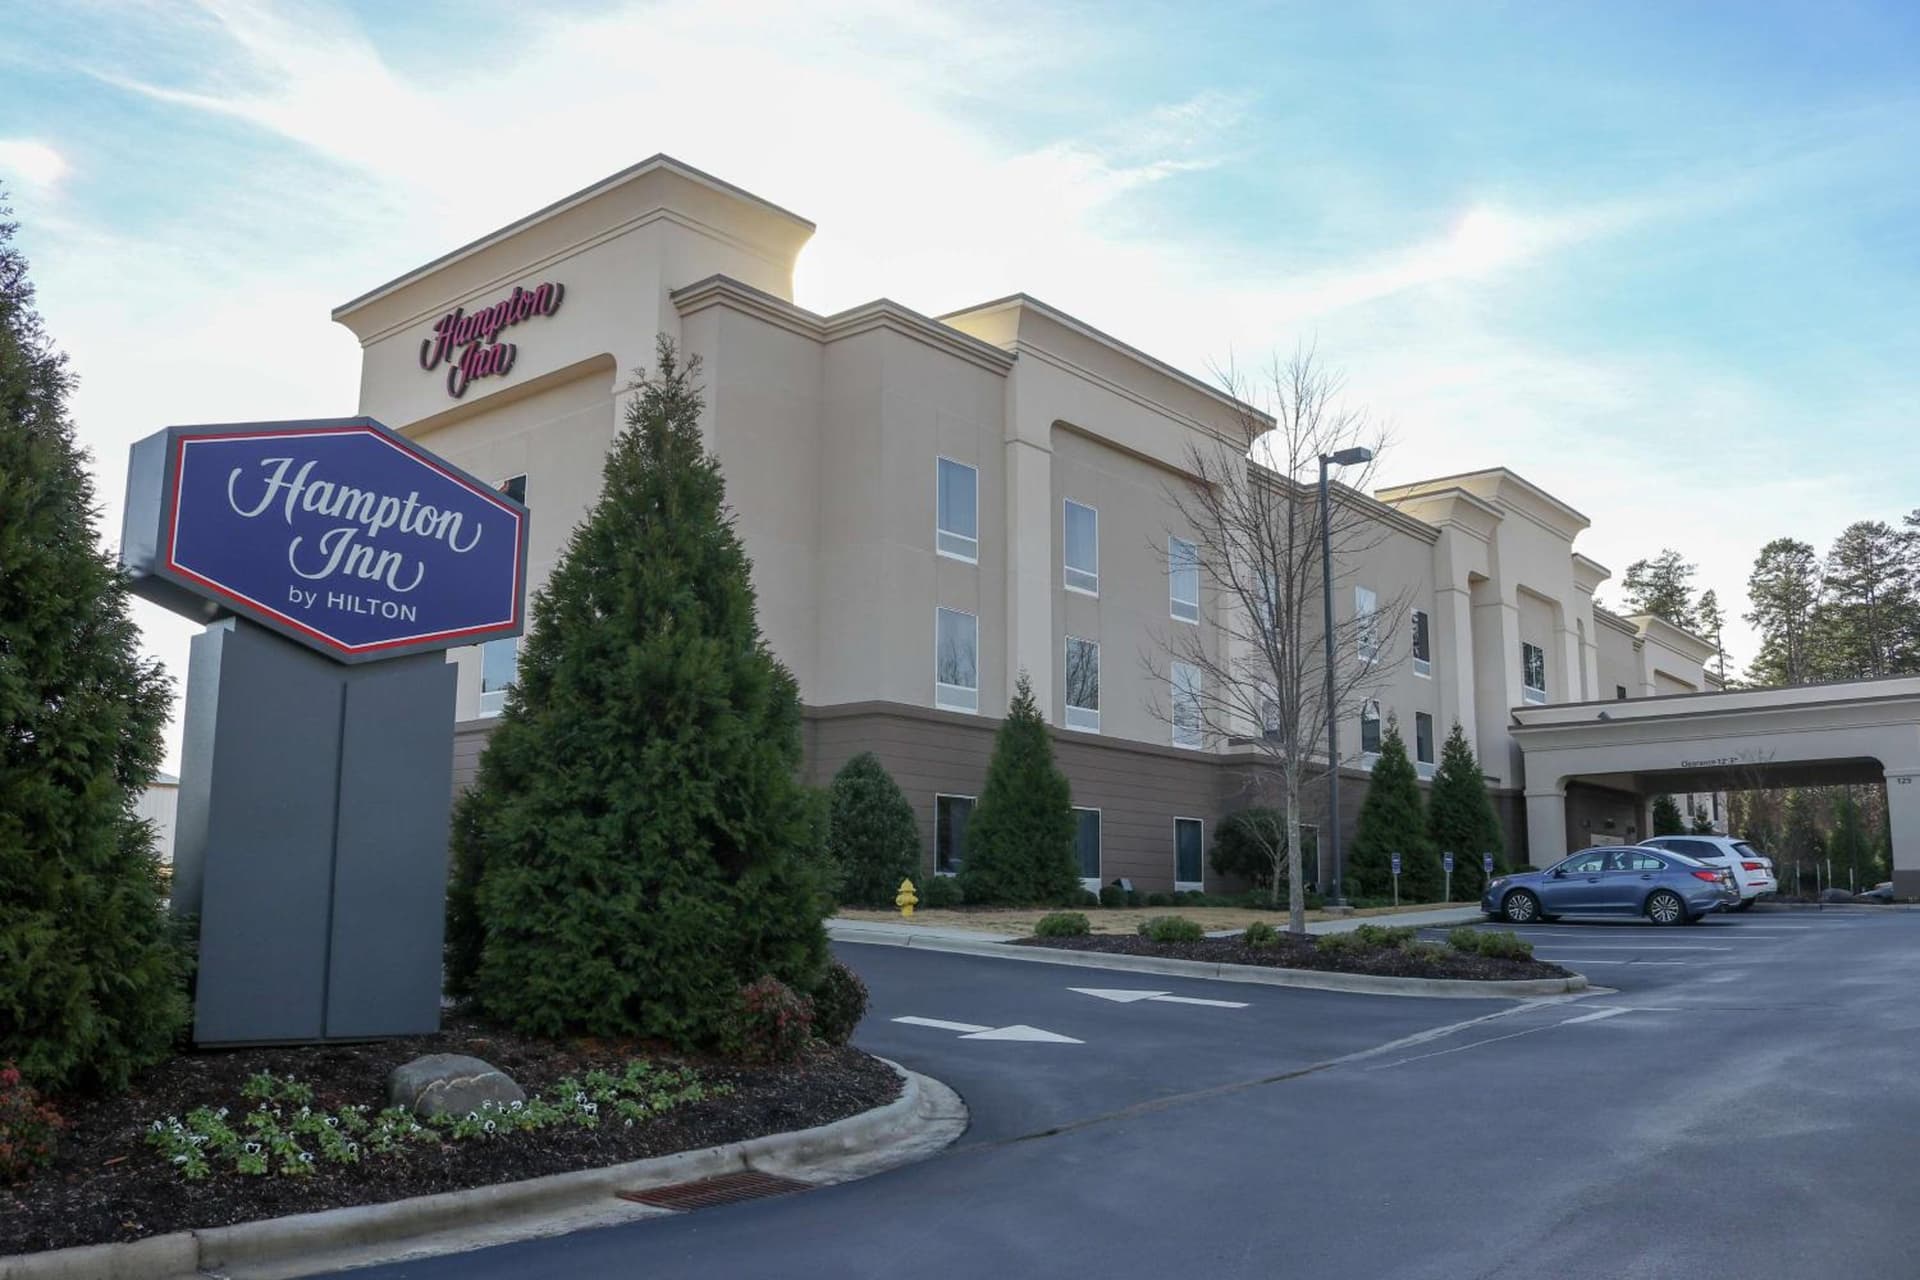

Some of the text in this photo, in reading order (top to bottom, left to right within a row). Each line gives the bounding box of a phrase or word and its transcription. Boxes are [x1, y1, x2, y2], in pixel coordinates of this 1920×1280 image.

[420, 282, 565, 371] Hampton
[447, 340, 517, 398] Inn
[228, 457, 482, 553] Hampton
[288, 528, 425, 592] Inn
[289, 584, 416, 622] by HILTON
